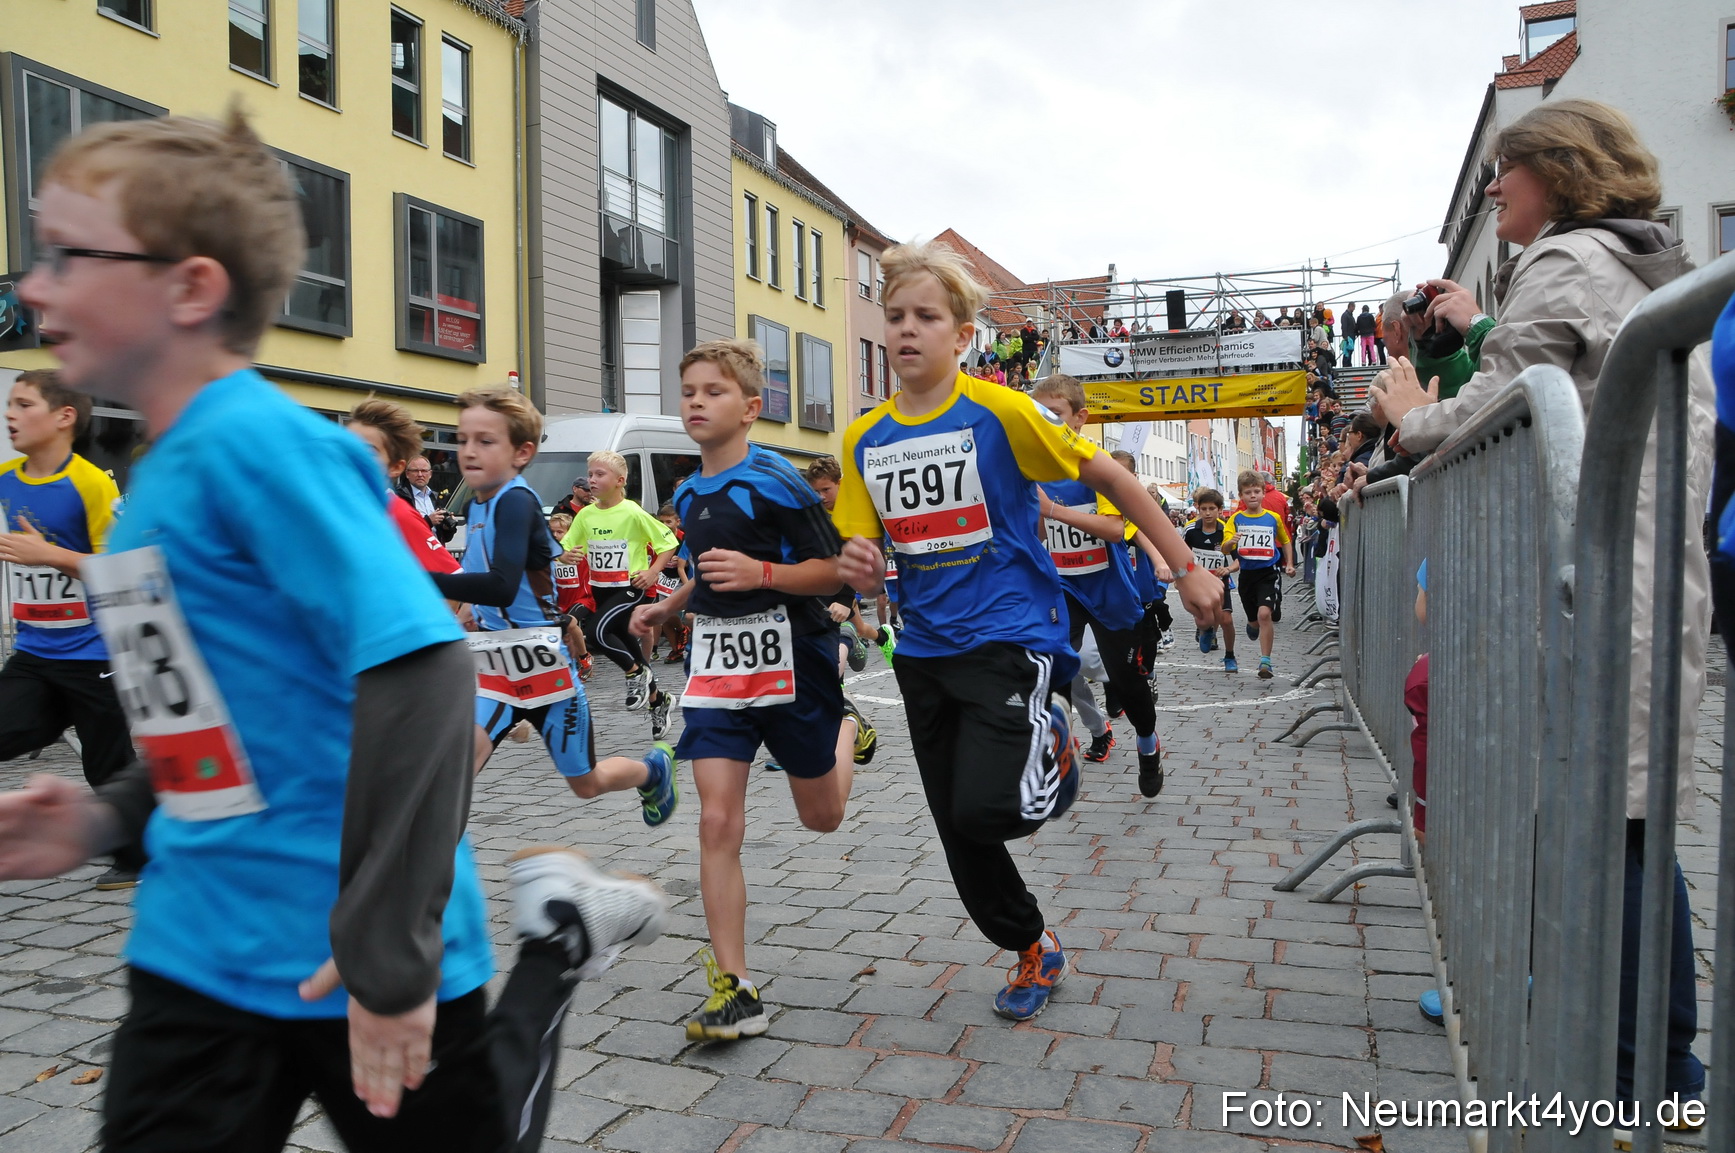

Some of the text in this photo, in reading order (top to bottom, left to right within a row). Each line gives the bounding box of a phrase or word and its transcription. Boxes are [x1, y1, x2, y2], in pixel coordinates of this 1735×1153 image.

[1159, 355, 1196, 364] Verbrauch.
[1197, 353, 1215, 362] Mehr
[1216, 351, 1256, 360] ahrfreude.
[1160, 341, 1255, 356] EfficientDynamics
[1139, 383, 1223, 406] START
[867, 444, 957, 469] PARTL Neumarkt
[876, 459, 967, 512] 7597
[894, 518, 929, 536] Felix
[926, 540, 954, 551] 2004
[1048, 525, 1097, 549] 7164
[1242, 534, 1271, 547] 7142
[588, 551, 624, 569] 7527
[1062, 555, 1084, 566] David
[14, 572, 77, 600] 7172
[721, 614, 770, 626] Neumarkt
[702, 629, 782, 669] 7598
[473, 644, 557, 676] 7106
